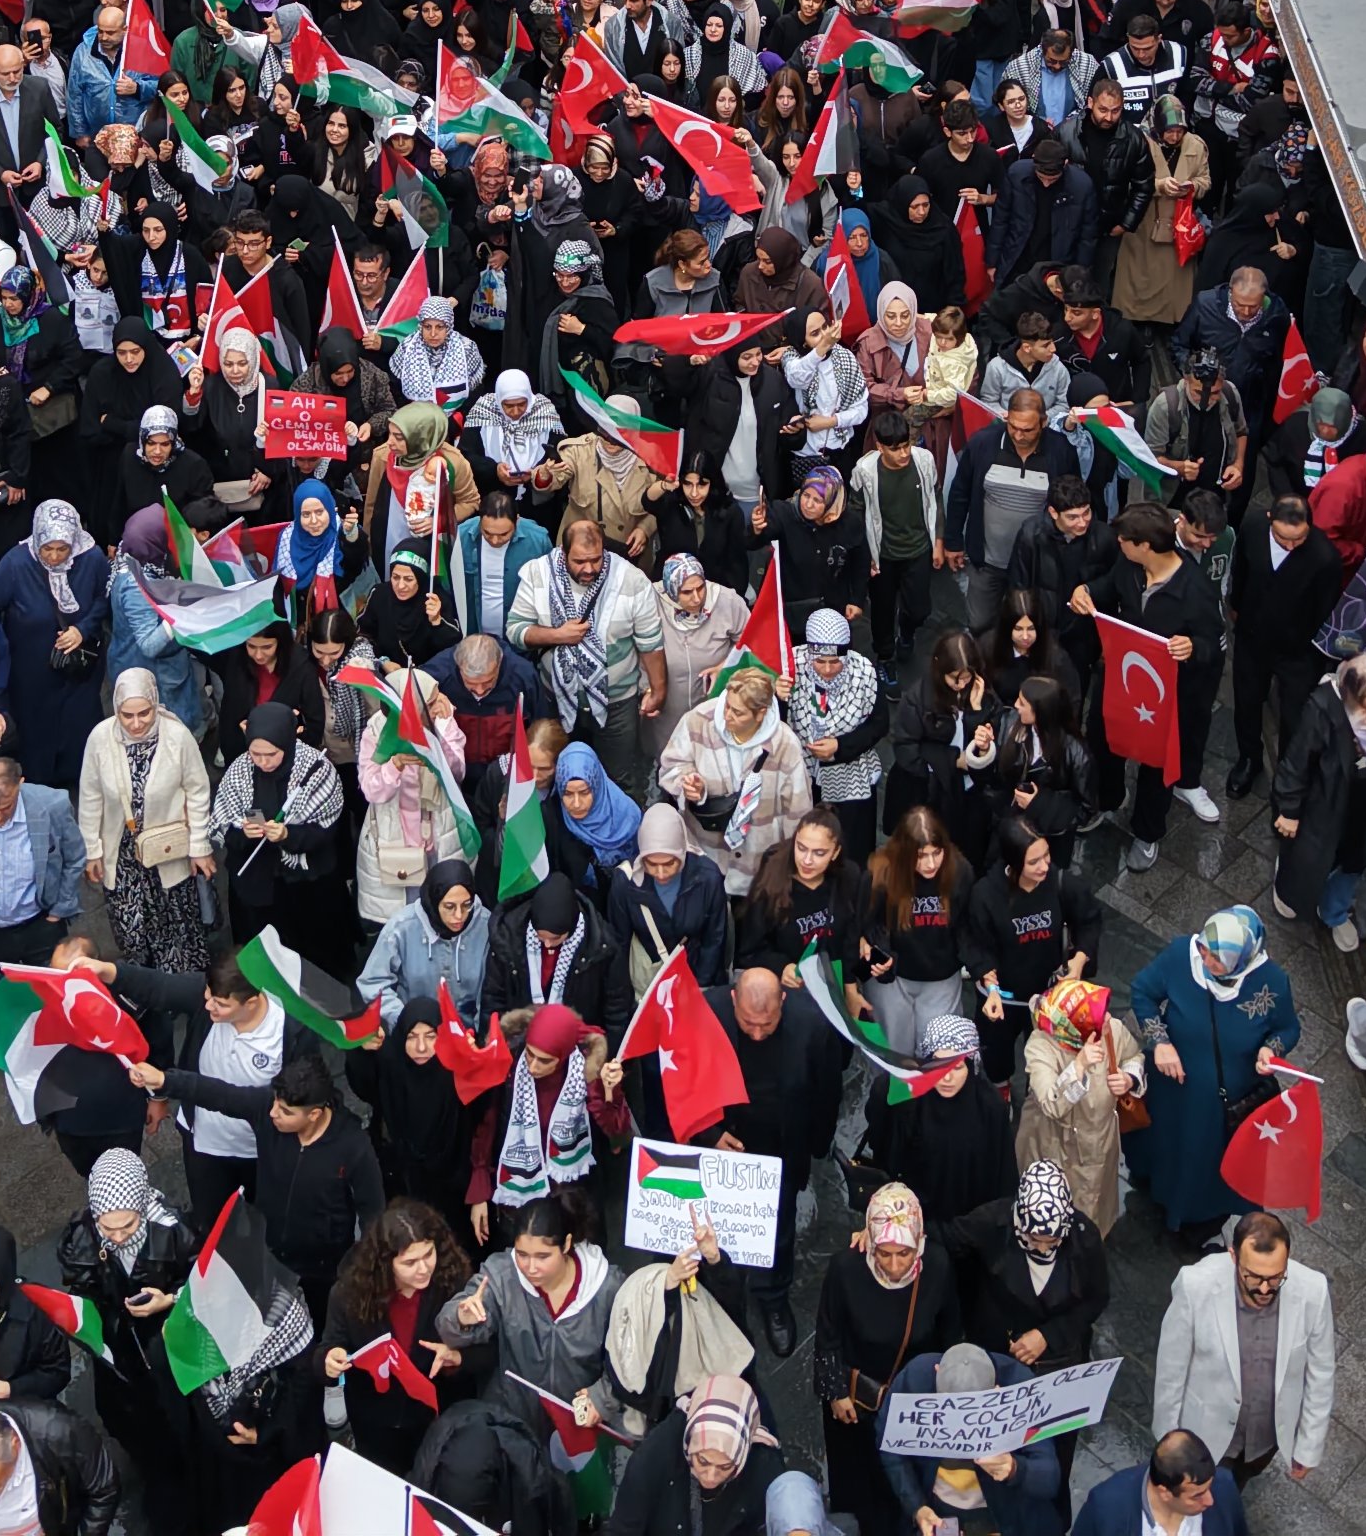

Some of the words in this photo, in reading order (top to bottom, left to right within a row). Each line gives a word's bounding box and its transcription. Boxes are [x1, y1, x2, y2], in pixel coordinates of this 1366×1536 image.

[291, 396, 316, 410] AH
[299, 410, 312, 423] O
[294, 429, 318, 441] BEN
[323, 431, 340, 443] DE
[898, 1410, 947, 1427] HER
